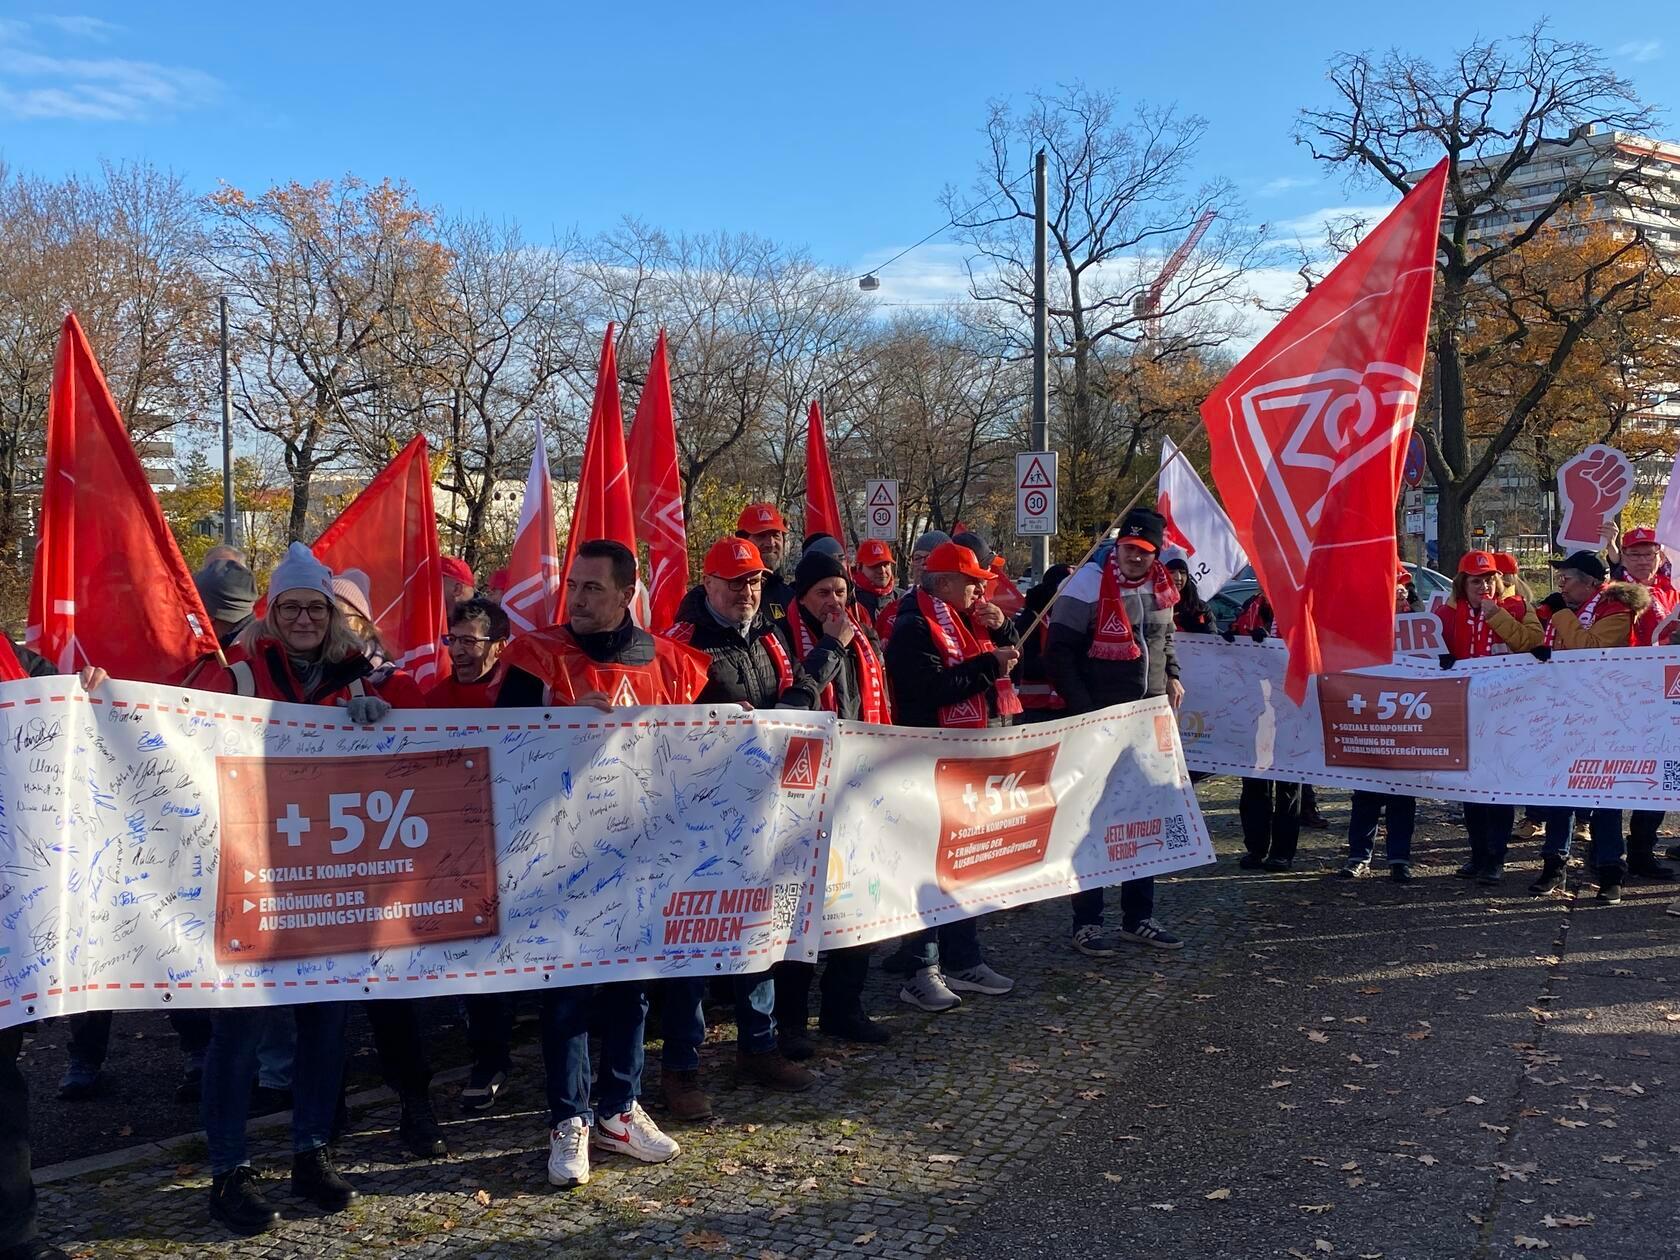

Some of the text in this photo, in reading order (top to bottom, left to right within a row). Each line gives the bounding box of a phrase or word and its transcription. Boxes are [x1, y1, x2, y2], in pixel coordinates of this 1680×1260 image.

[1029, 497, 1043, 509] 30
[876, 512, 888, 522] 30
[1377, 691, 1432, 720] 5%
[1339, 723, 1424, 732] SOZIALE KOMPONENTE
[1341, 735, 1396, 746] ERHÖHUNG DER
[1343, 746, 1450, 756] AUSBILDUNGSVERGÜTUNGEN
[1568, 759, 1657, 775] JETZT MITGLIED
[984, 770, 1030, 816] 5%
[1567, 776, 1616, 790] WERDEN
[328, 788, 429, 855] 5%
[957, 815, 1027, 839] SOZIALE KOMPONENTE
[1104, 818, 1162, 844] JETZT MITGLIED
[952, 838, 1038, 870] AUSBILDUNGSVERGÜTUNGEN
[955, 838, 1004, 858] ERHÖHUNG DER
[1106, 840, 1138, 862] WERDEN
[258, 858, 414, 883] SOZIALE KOMPONENTE
[258, 890, 365, 912] ERHÖHUNG DER
[662, 890, 717, 917] JETZT
[258, 898, 464, 931] AUSBILDUNGSVERGÜTUNGEN
[663, 916, 744, 945] WERDEN
